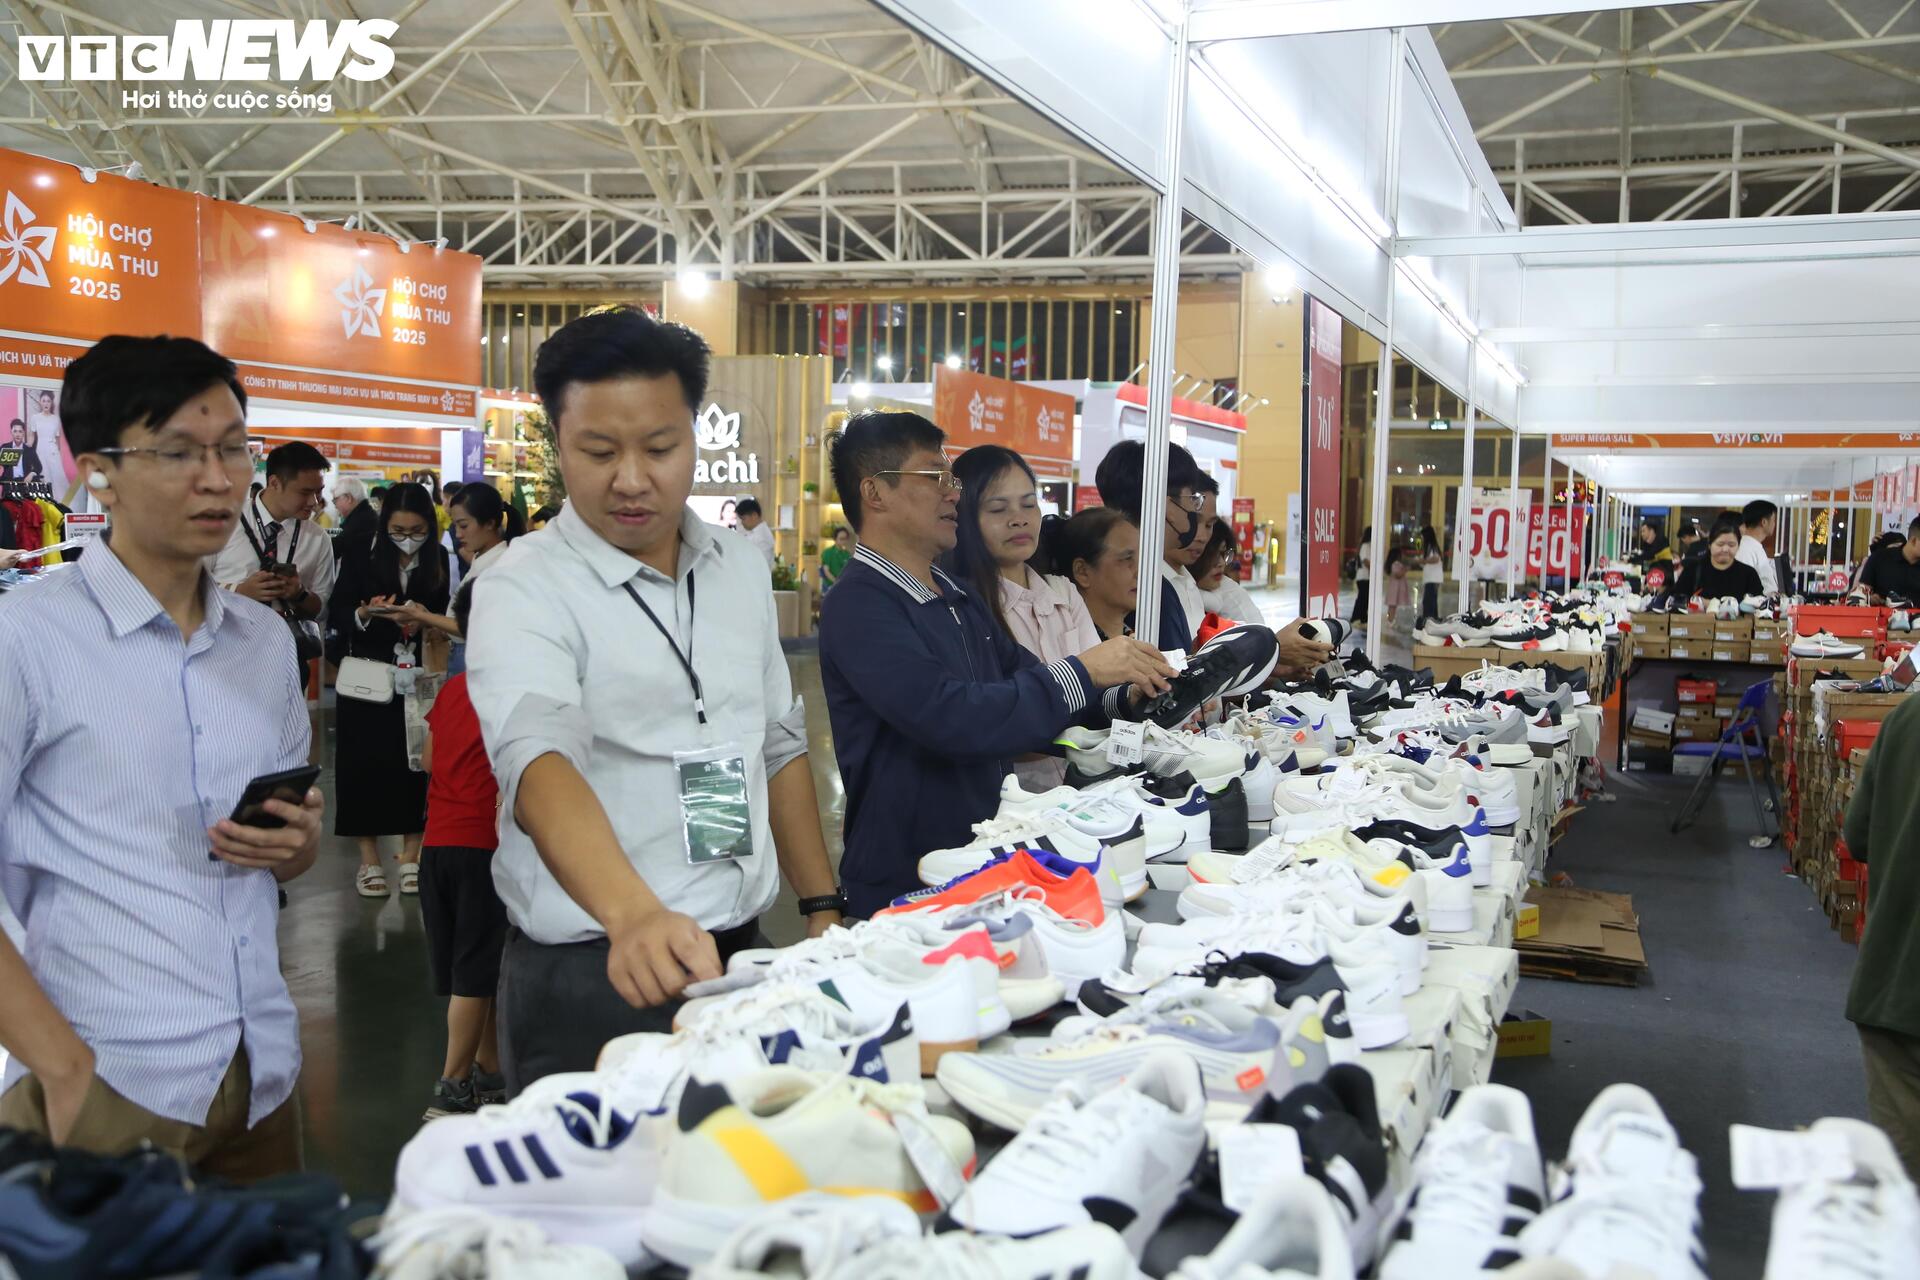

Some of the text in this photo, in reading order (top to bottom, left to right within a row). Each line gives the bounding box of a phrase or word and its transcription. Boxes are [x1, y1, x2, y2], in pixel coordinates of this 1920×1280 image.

[68, 212, 152, 251] HỘI CHỢ
[68, 243, 159, 278] MÙA THU
[69, 276, 121, 301] 2025
[392, 276, 448, 305] HỘI CHỢ
[425, 307, 451, 325] THU
[393, 327, 426, 346] 2025
[0, 351, 19, 363] ỊCH
[1560, 433, 1633, 444] SUPER MEGA SALE
[694, 451, 759, 483] achi
[1314, 507, 1335, 543] SALE
